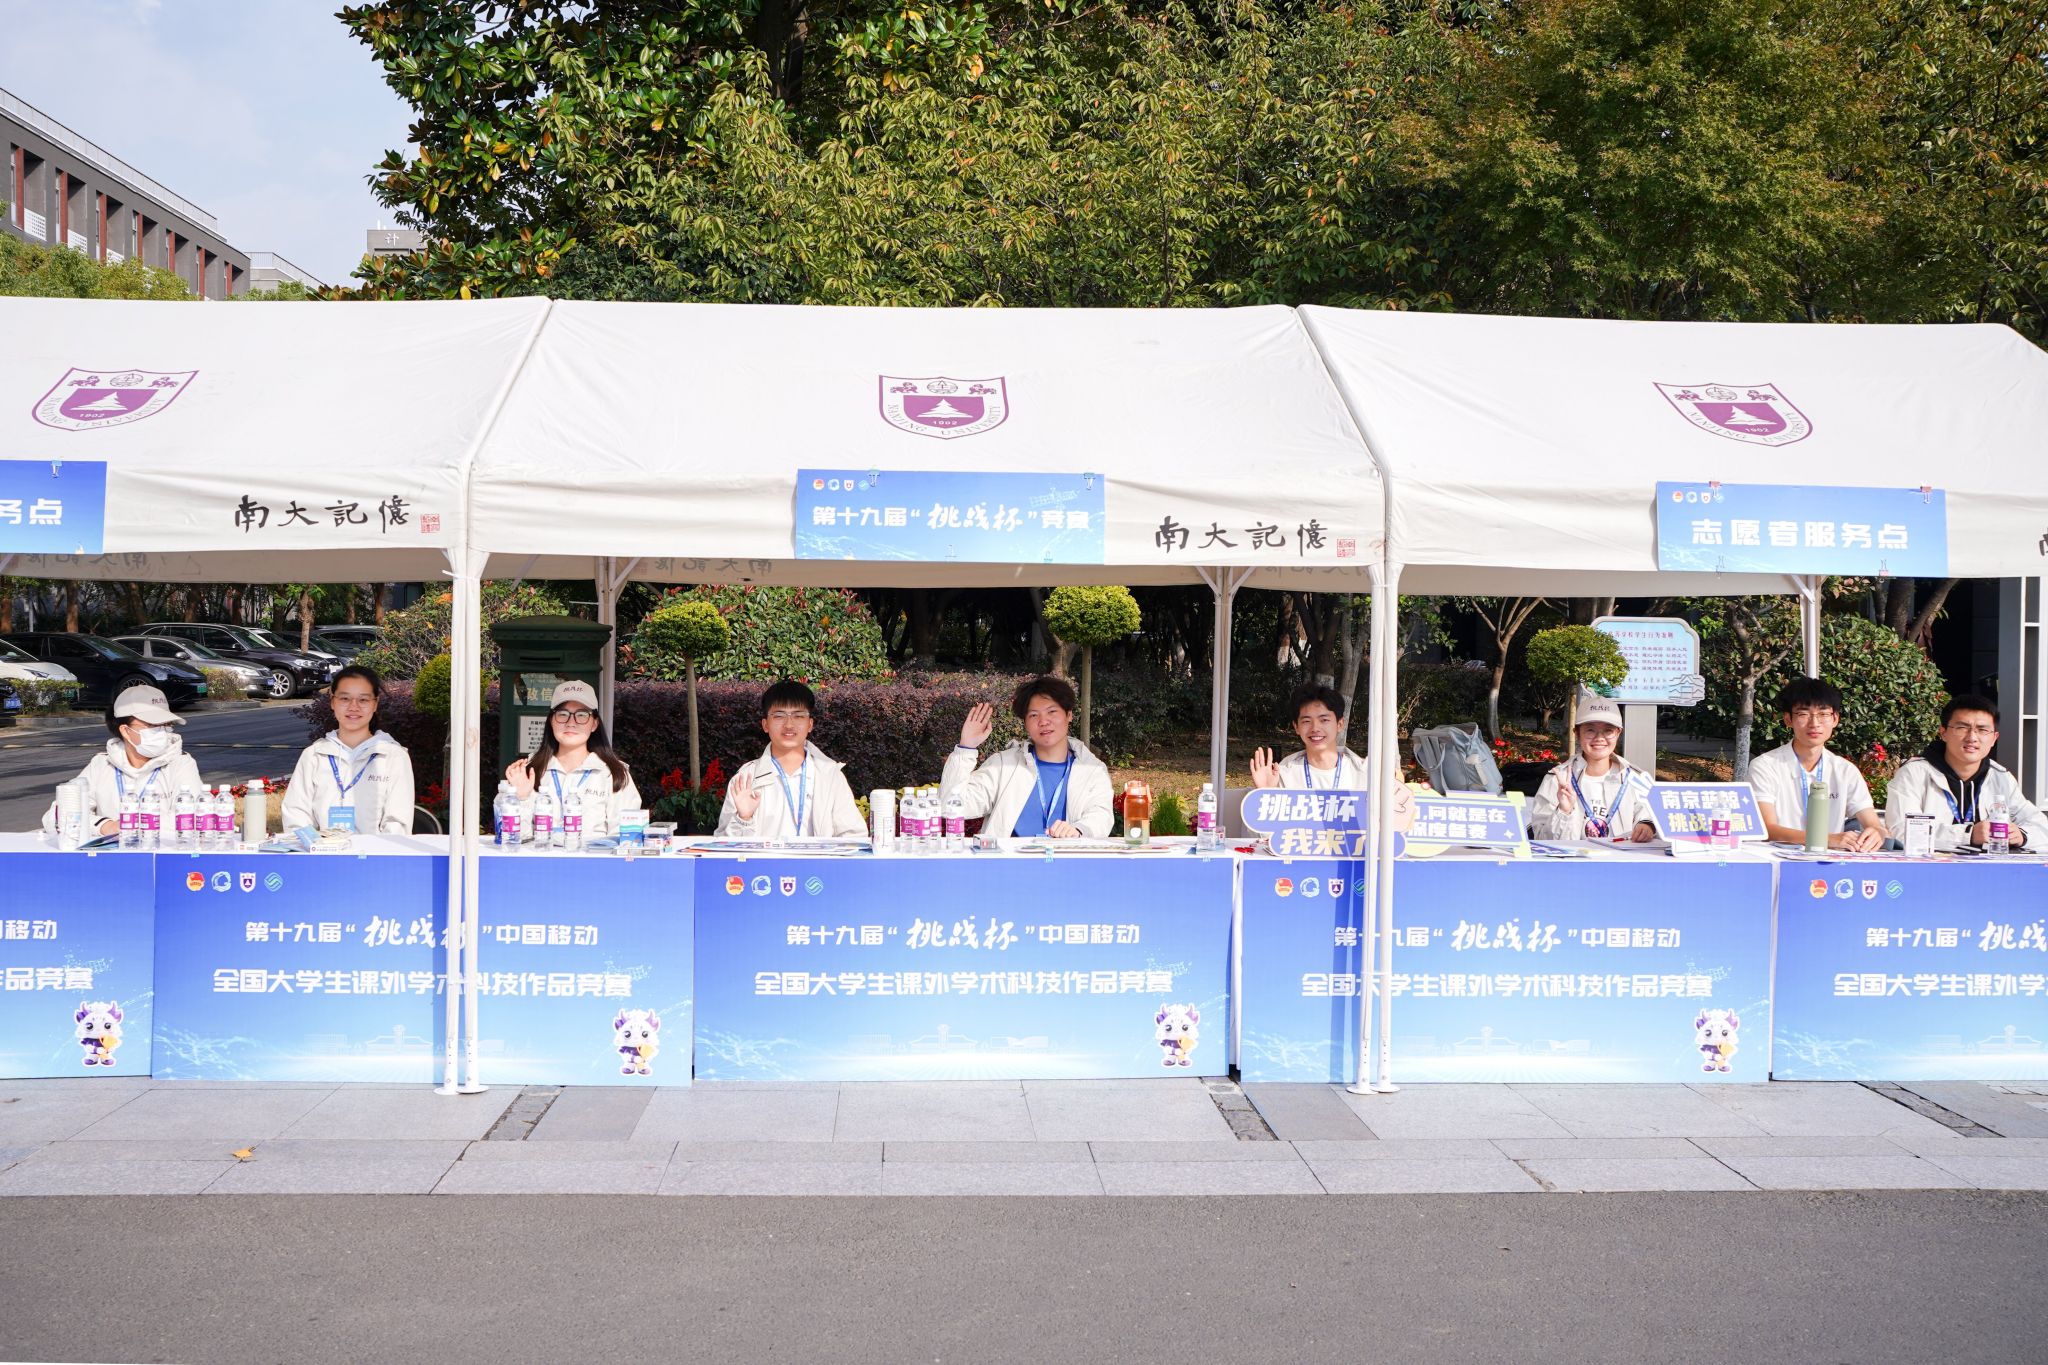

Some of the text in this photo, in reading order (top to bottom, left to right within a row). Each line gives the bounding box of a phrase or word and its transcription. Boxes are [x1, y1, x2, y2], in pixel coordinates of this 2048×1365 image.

[1691, 519, 1909, 550] 志愿者服务点
[1257, 794, 1360, 822] 挑战杯
[1667, 812, 1754, 832] 挑战赢!
[0, 919, 57, 940] 移动
[0, 967, 93, 991] 品竞赛
[754, 971, 1173, 995] 全国大学生课外学术科技作品竞赛
[1833, 973, 2048, 996] 全国大学生课外学
